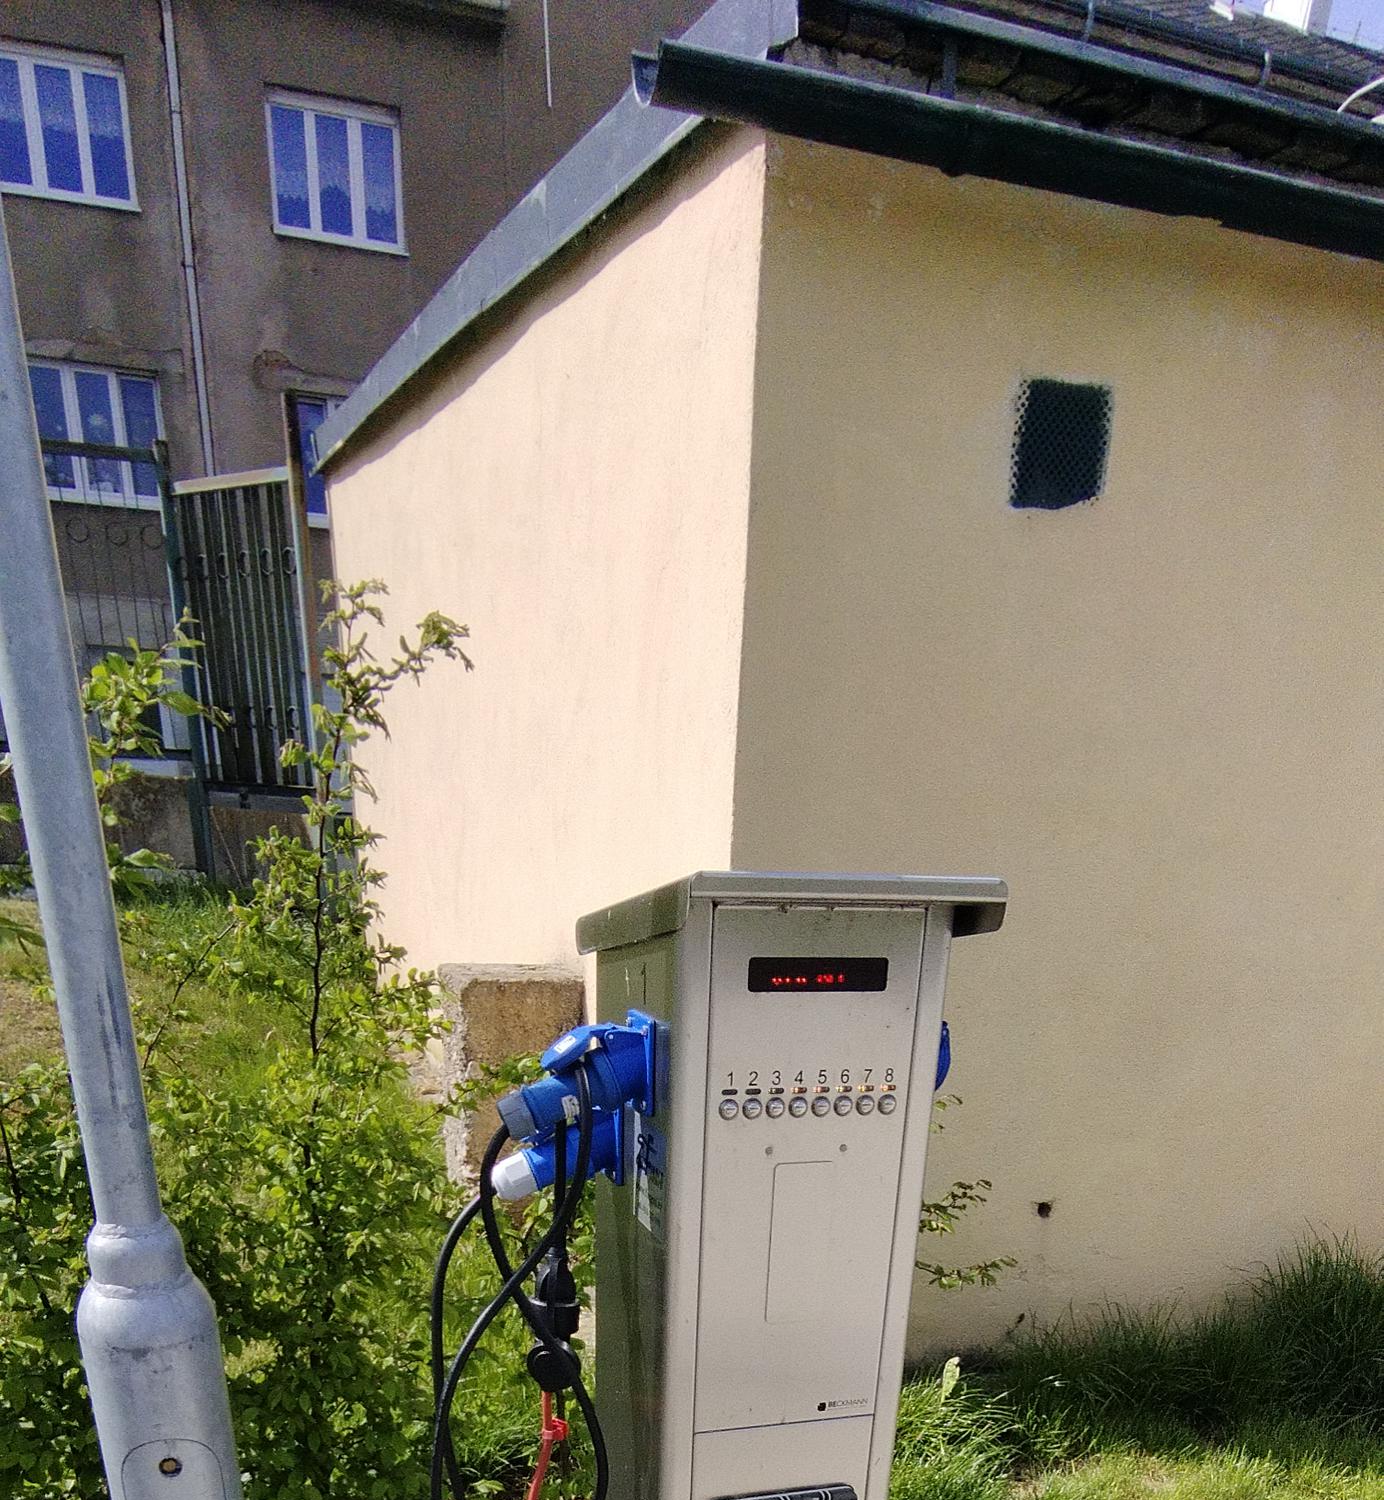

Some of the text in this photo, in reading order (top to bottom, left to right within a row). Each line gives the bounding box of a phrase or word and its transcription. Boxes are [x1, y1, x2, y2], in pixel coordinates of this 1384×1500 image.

[727, 1068, 894, 1086] 1 2 3 4 5 6 7 8
